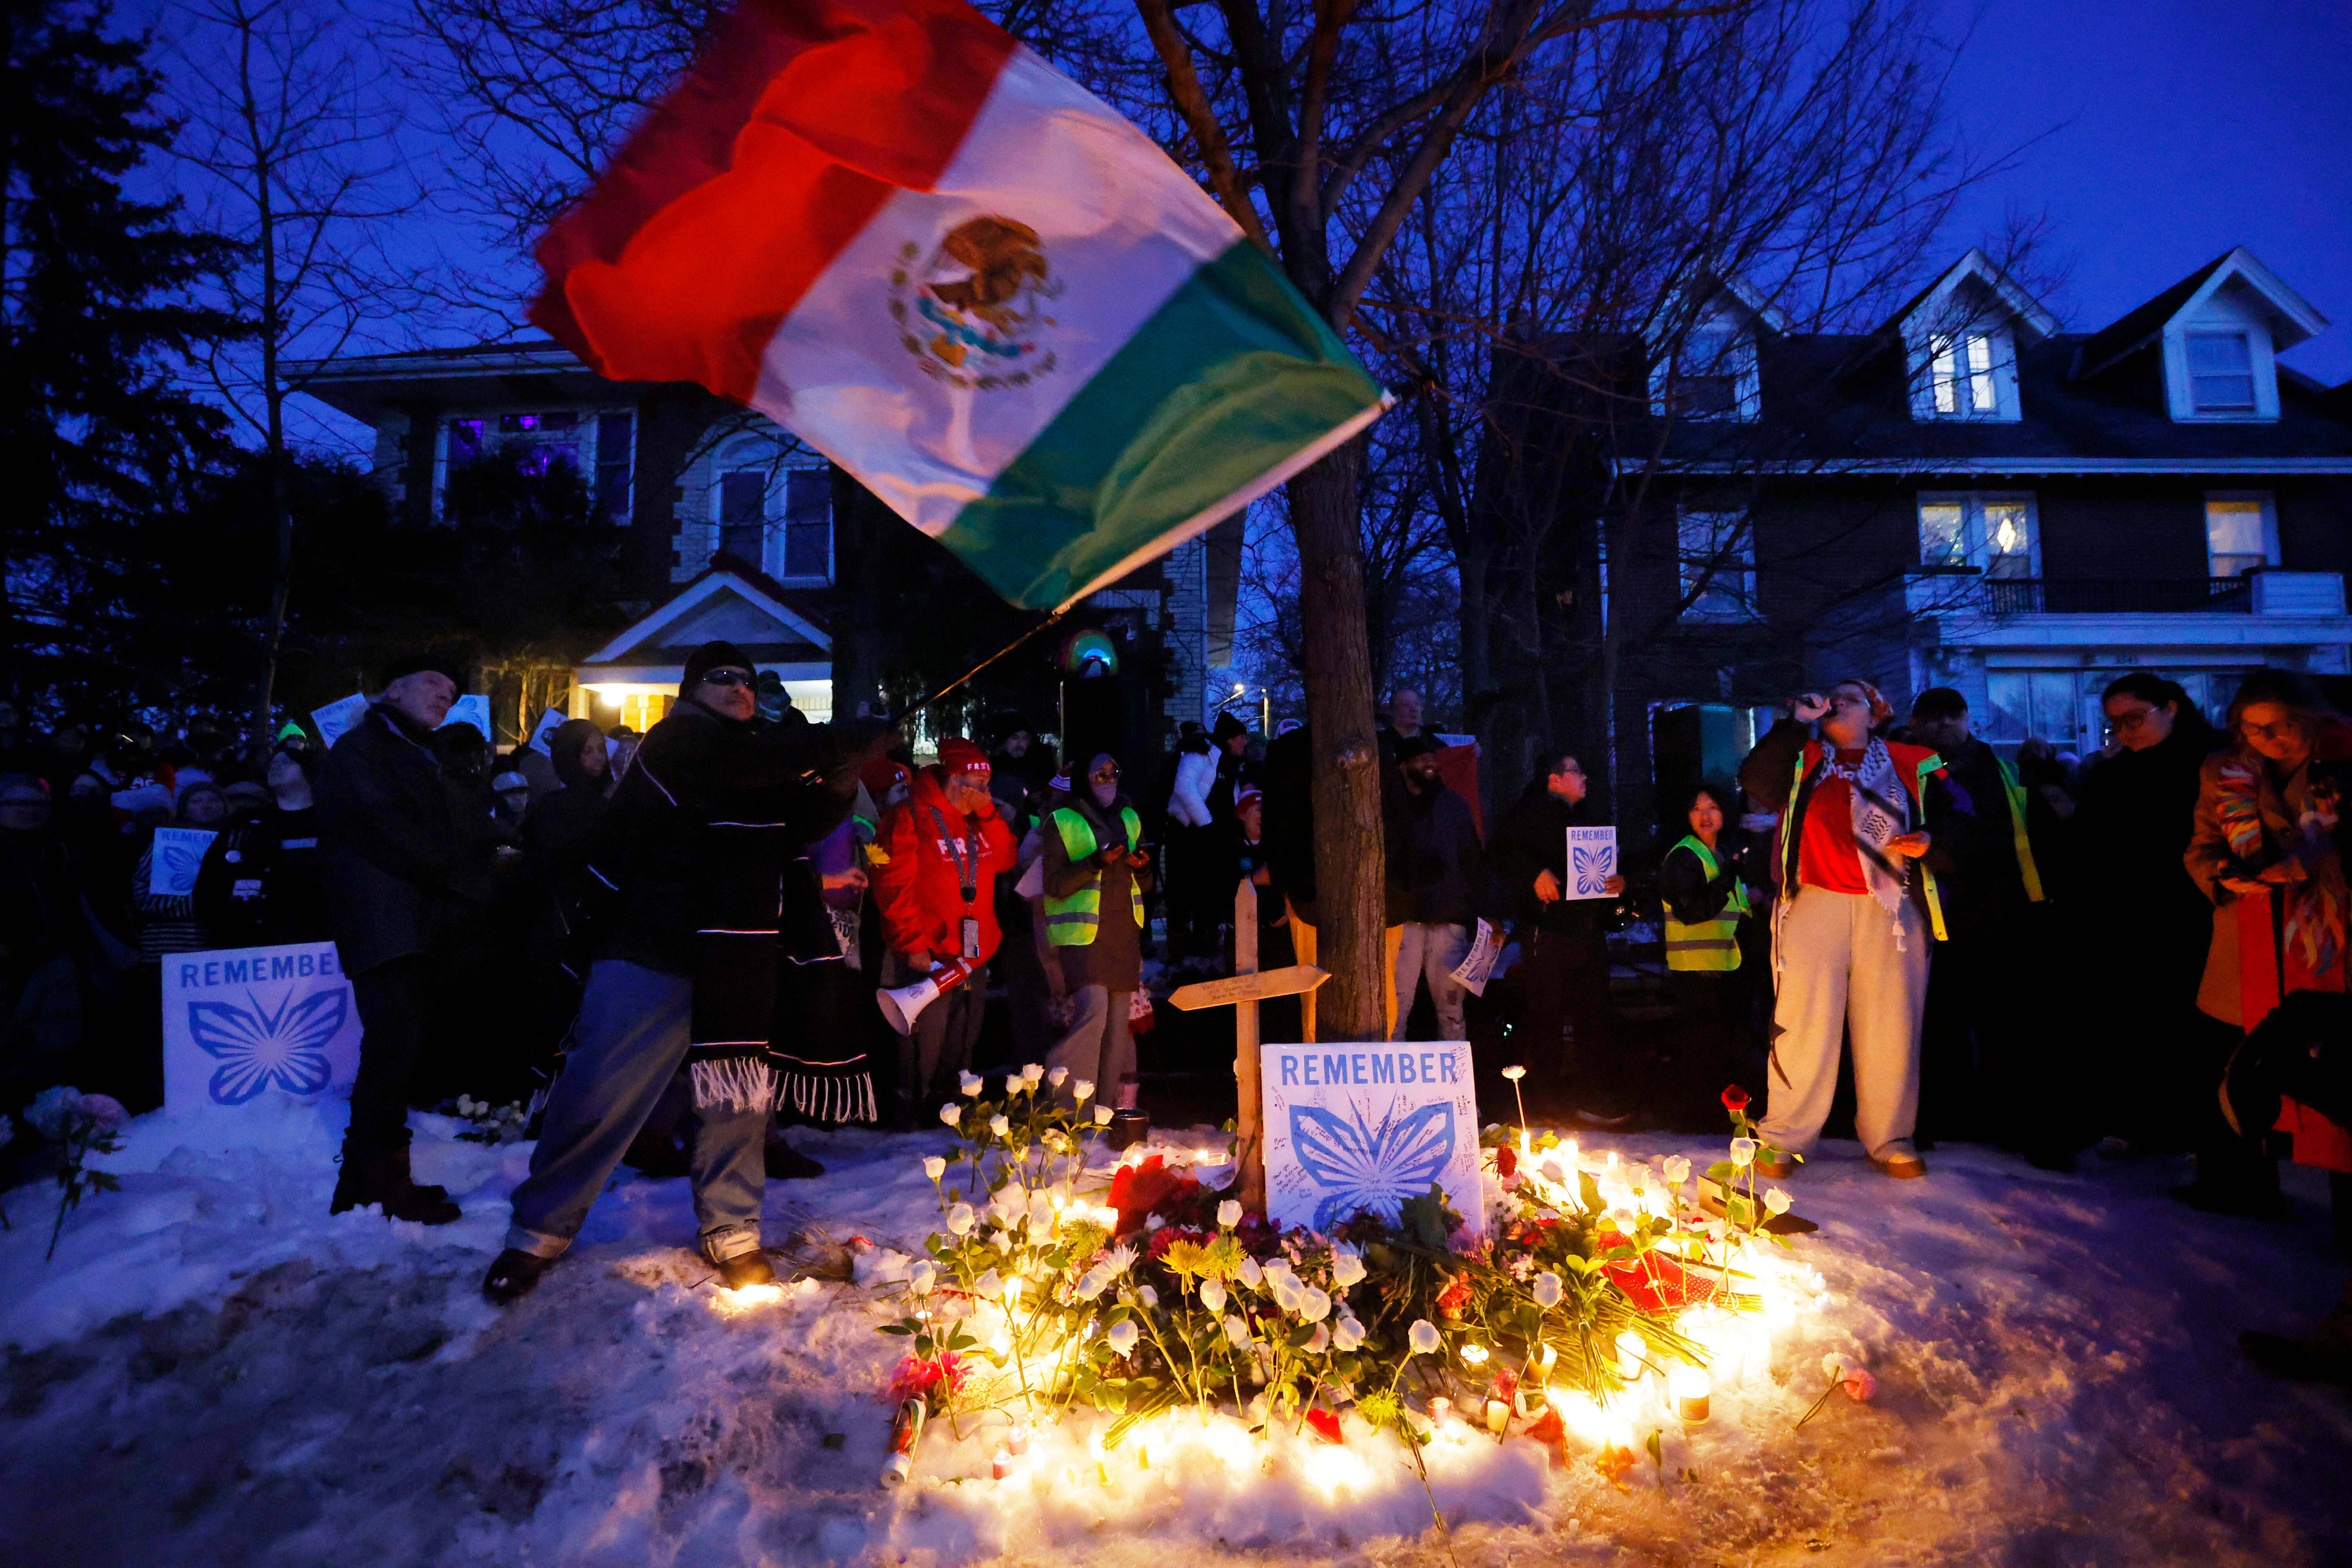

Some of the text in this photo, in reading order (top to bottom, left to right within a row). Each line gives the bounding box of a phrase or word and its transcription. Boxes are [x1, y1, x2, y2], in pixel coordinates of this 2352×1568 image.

[162, 831, 212, 842] REMEM
[1571, 830, 1613, 840] REMEMBER
[1456, 923, 1485, 977] REMEMBER
[181, 952, 343, 987] REMEMBE
[1281, 1053, 1457, 1085] REMEMBER
